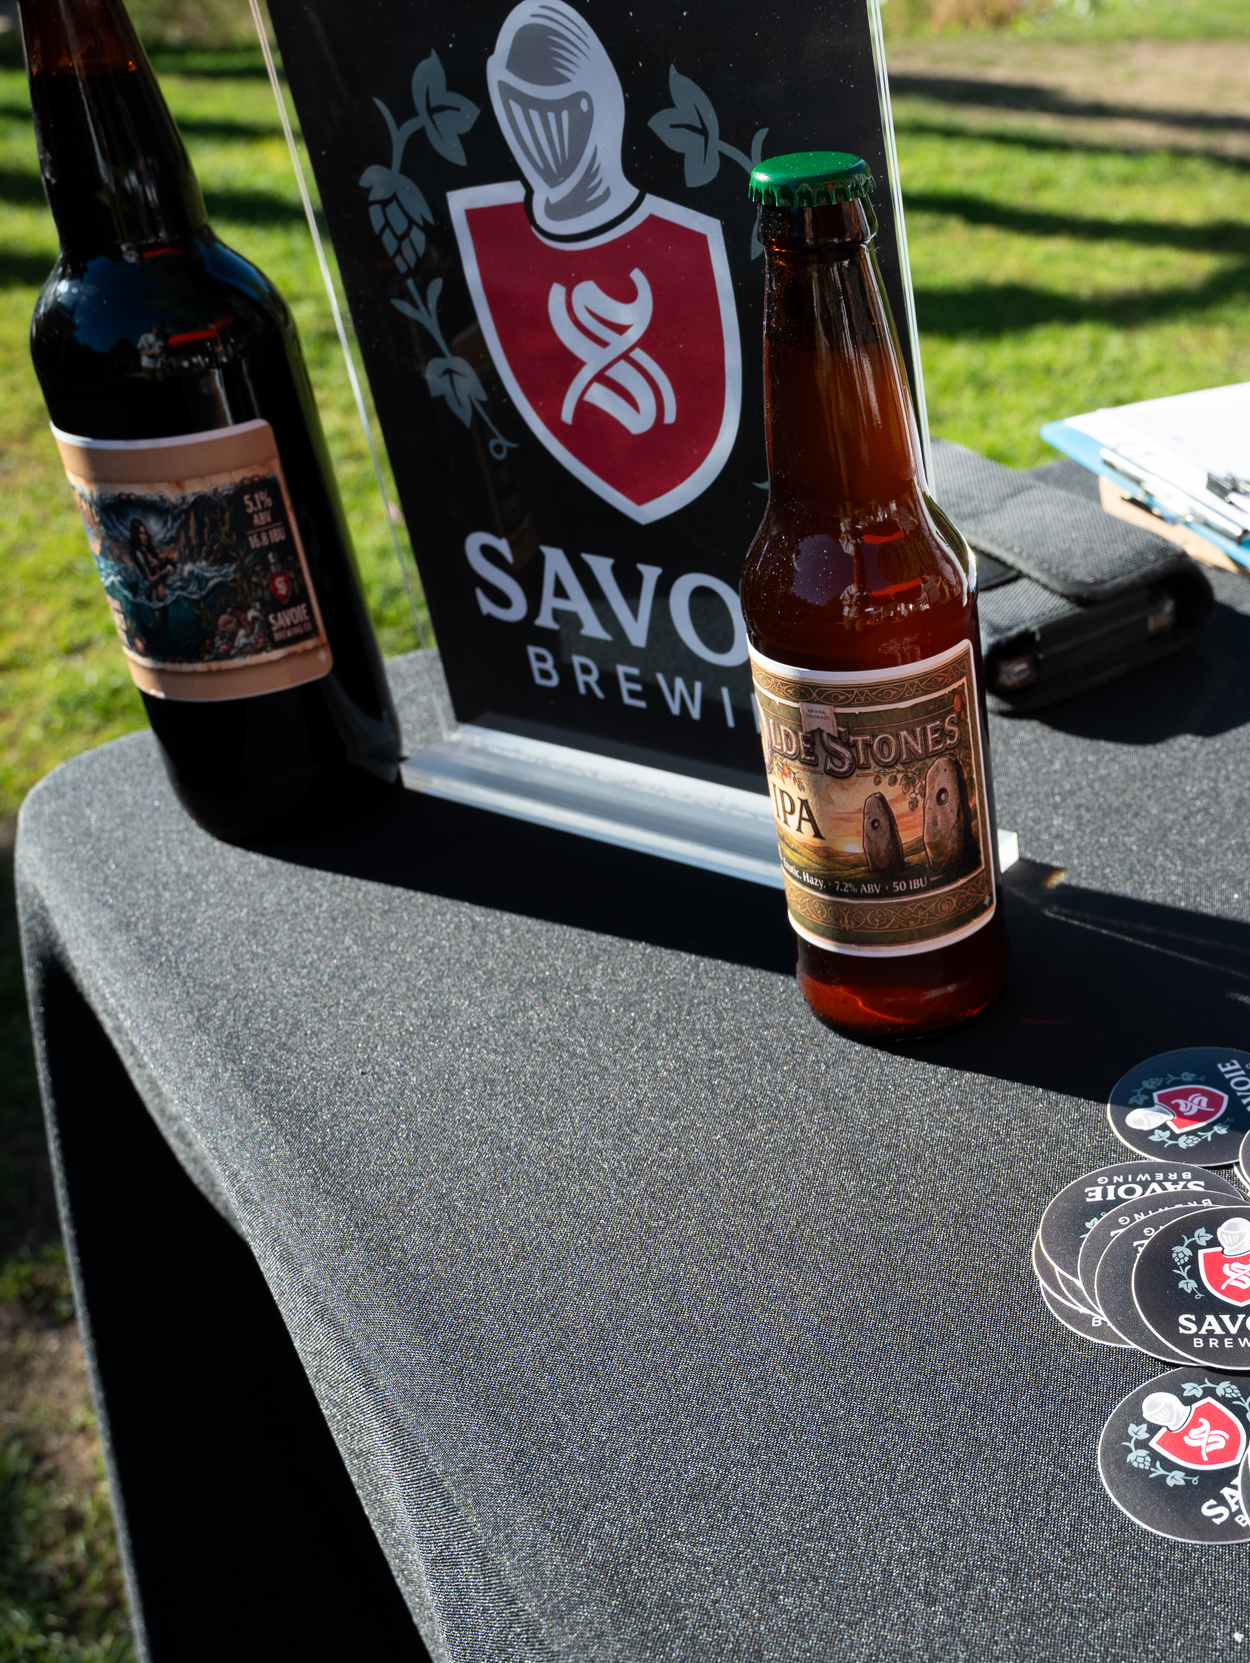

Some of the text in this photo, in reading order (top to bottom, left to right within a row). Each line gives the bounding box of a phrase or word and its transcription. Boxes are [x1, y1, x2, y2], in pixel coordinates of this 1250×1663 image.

[243, 489, 273, 514] 5.1%
[252, 510, 272, 527] ABV
[268, 525, 286, 543] IBU
[464, 531, 749, 667] SAVO
[268, 603, 310, 631] SAVOIE
[527, 645, 761, 734] BREWI
[764, 712, 961, 778] LDE STONES
[772, 782, 826, 841] IPA
[802, 871, 826, 890] Hazy.
[834, 881, 858, 893] 7.2%
[860, 883, 882, 894] ABV
[893, 881, 907, 892] 50
[909, 877, 928, 890] IBU
[1097, 1172, 1192, 1184] BREWING
